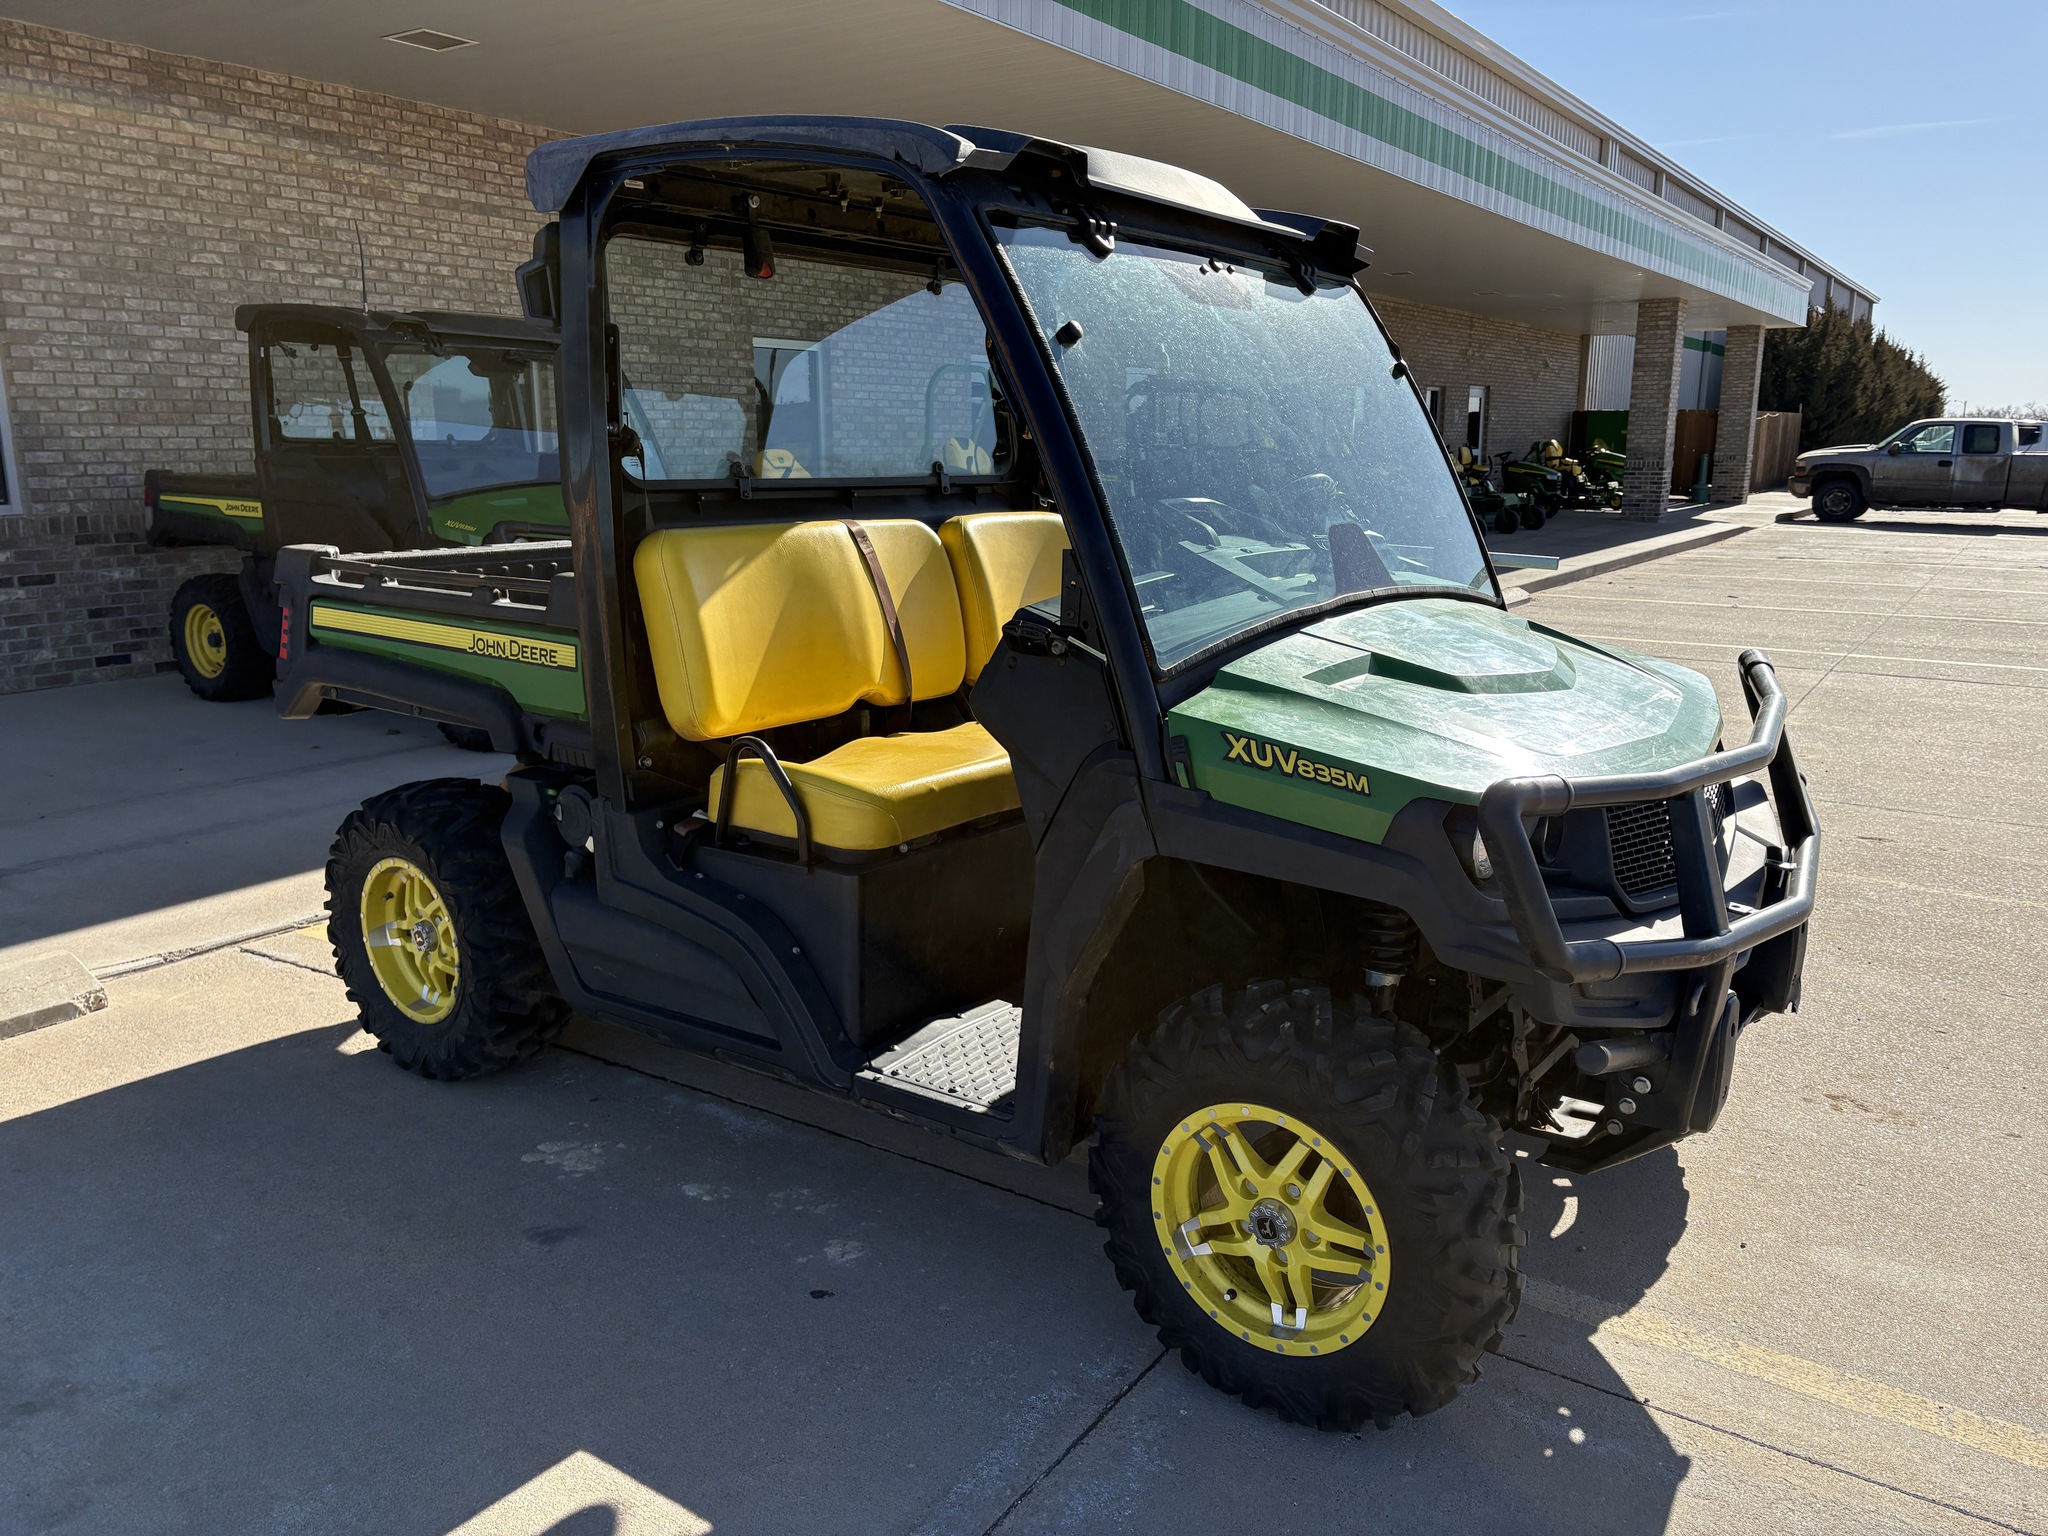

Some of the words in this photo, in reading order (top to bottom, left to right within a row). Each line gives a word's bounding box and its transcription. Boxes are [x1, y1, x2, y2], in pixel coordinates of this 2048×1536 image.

[225, 503, 240, 511] JOHN
[240, 503, 260, 513] DEERE
[468, 633, 506, 656] JOHN
[509, 639, 558, 665] DEERE
[1225, 732, 1370, 794] XUV835M
